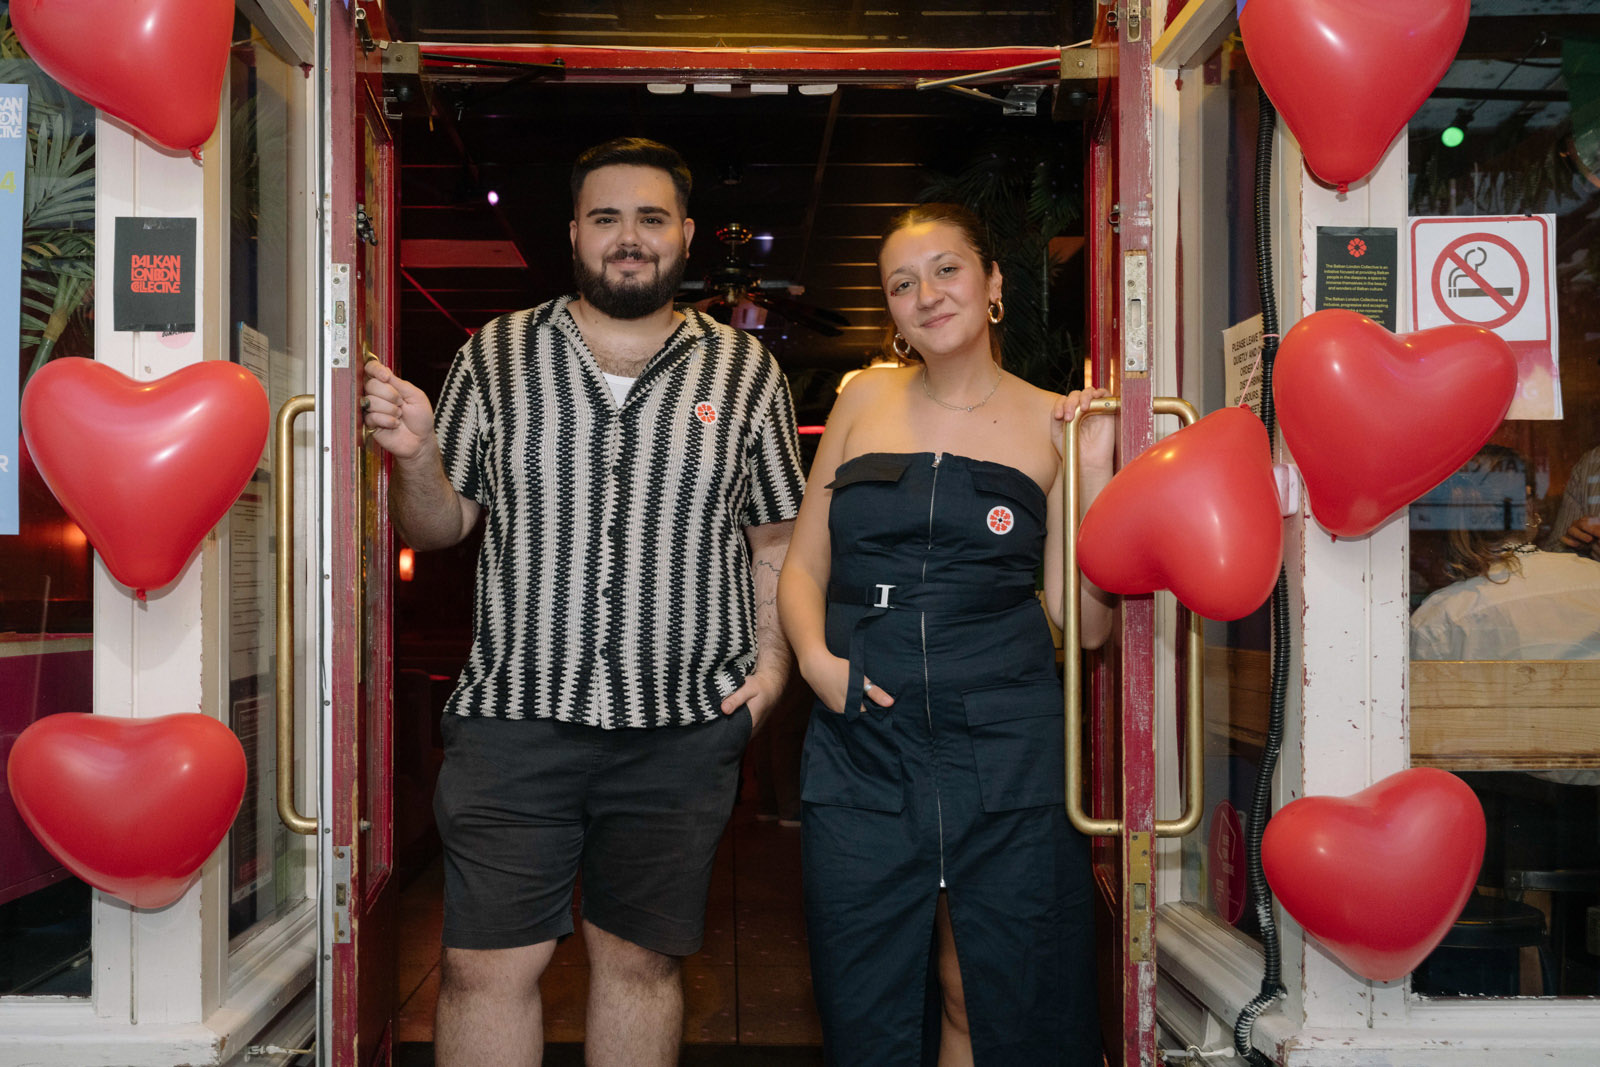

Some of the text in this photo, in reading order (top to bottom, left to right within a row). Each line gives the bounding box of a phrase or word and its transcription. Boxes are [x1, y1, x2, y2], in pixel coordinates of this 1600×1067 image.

[131, 254, 181, 268] BALKAN
[1232, 338, 1246, 352] PLEASE
[1246, 332, 1258, 346] LEAVE
[1233, 351, 1248, 366] QUIETLY
